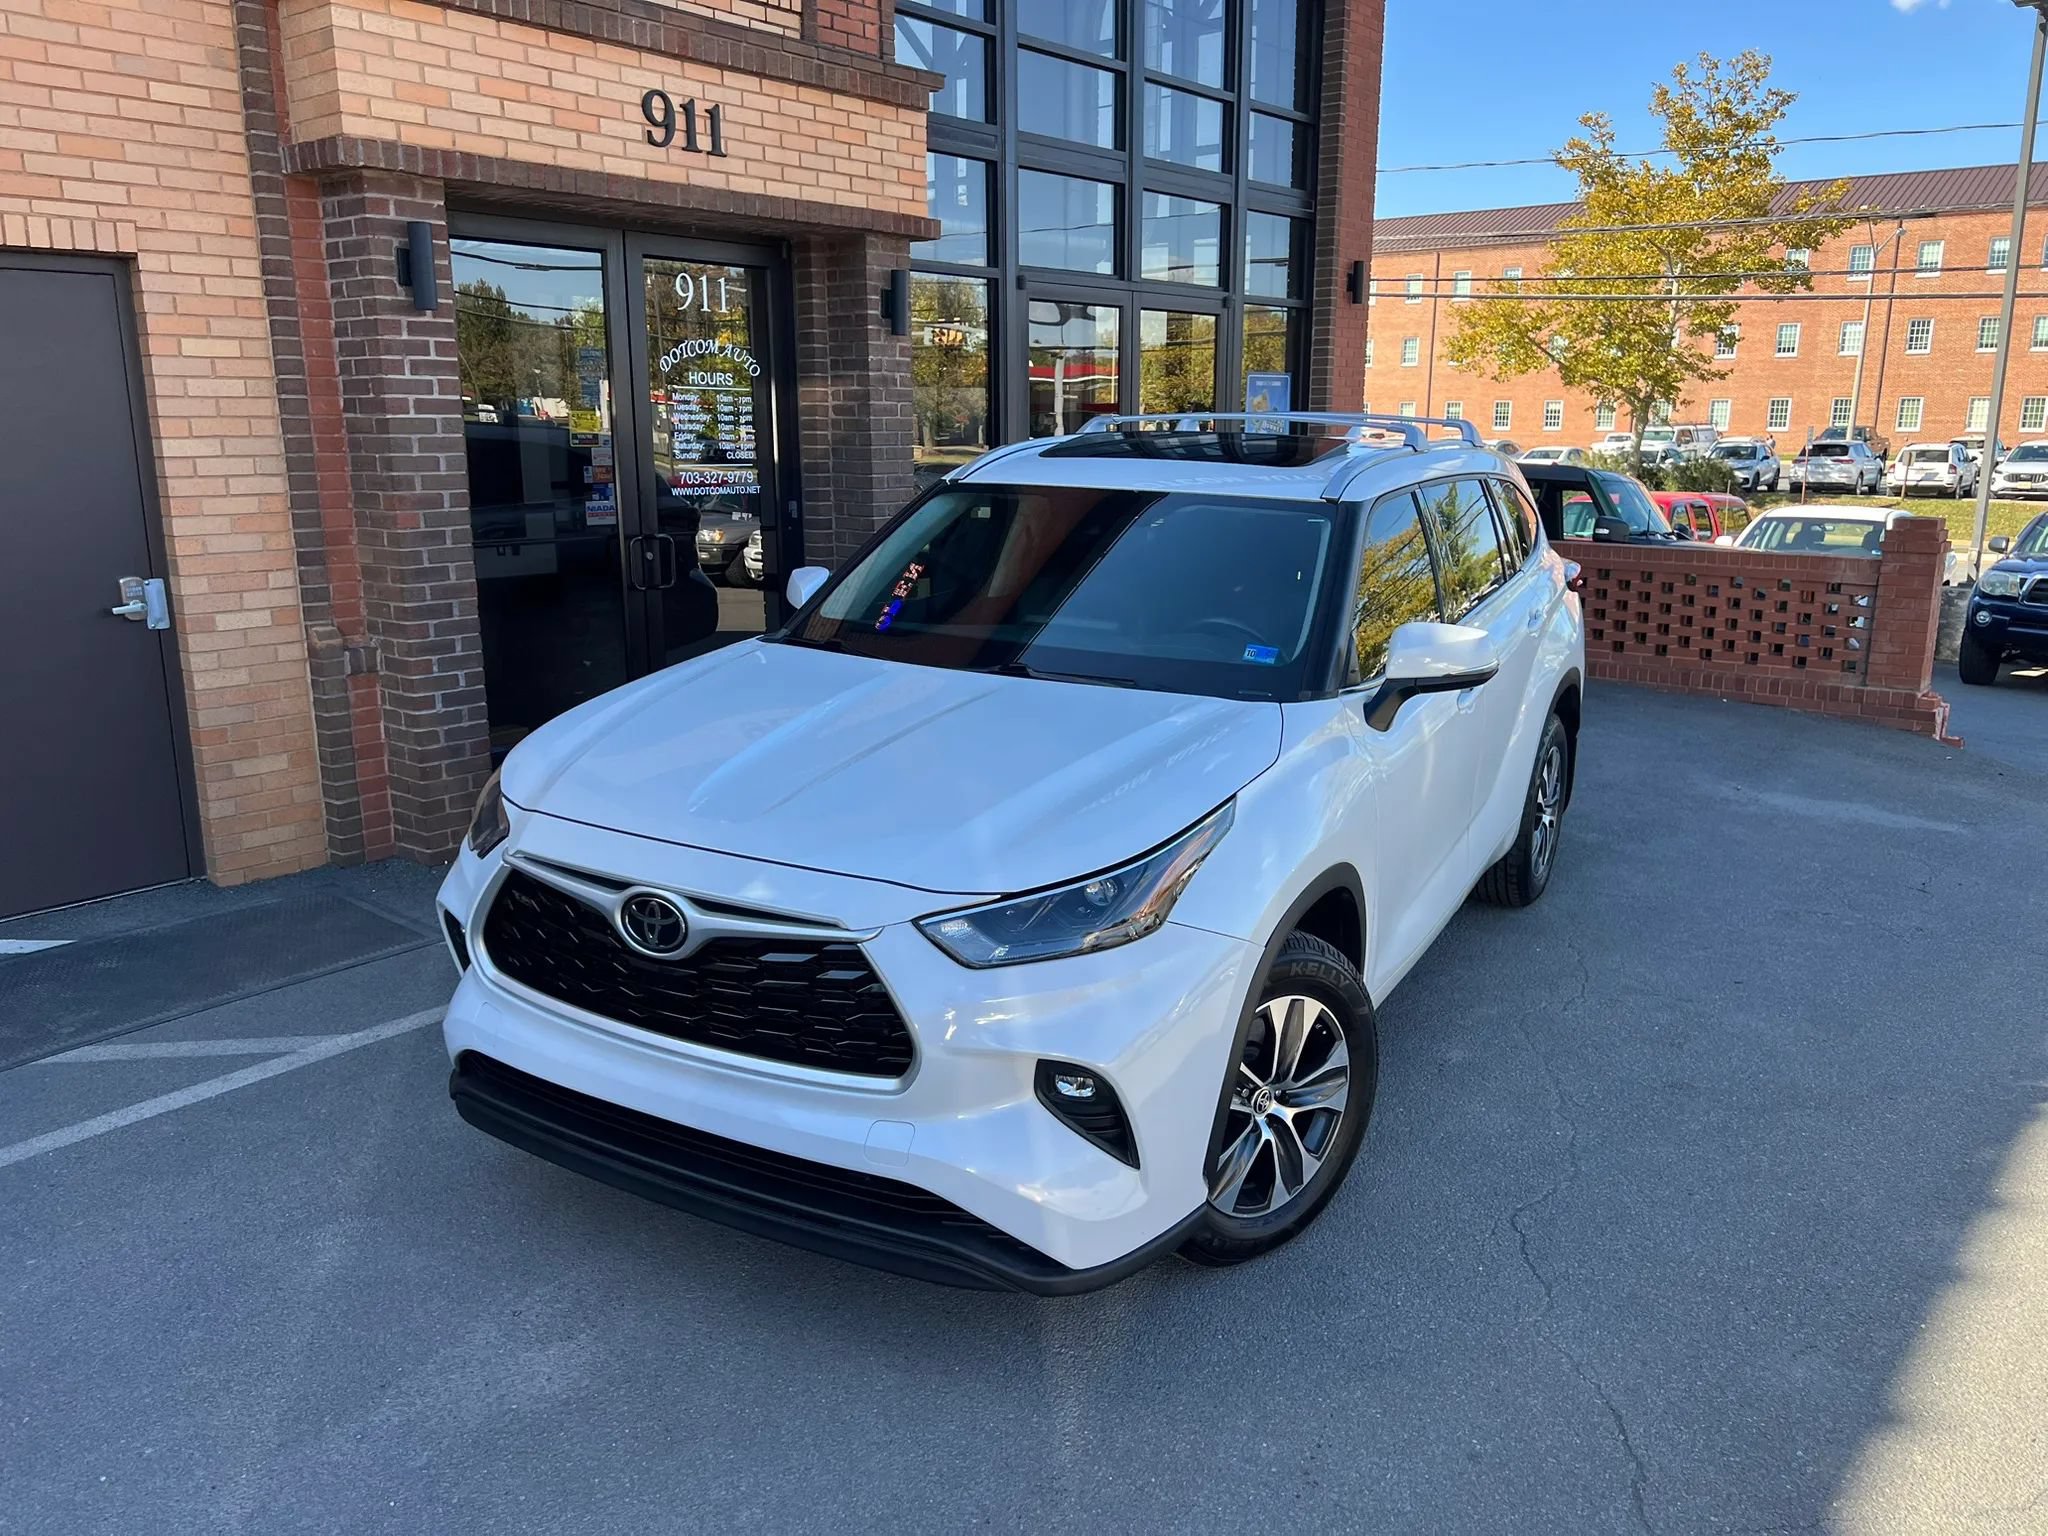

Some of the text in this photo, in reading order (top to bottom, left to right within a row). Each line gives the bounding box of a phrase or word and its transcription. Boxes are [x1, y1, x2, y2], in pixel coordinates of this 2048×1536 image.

[641, 89, 728, 157] 911
[675, 272, 730, 314] 911
[659, 339, 761, 377] DOTCOM AUTO
[688, 371, 734, 386] HOURS
[675, 451, 754, 461] Sunday: CLOSED
[679, 471, 754, 484] 703-327-9779
[671, 486, 761, 496] WWW.DOTCOMAUTO.NET
[1289, 961, 1350, 988] KELLY
